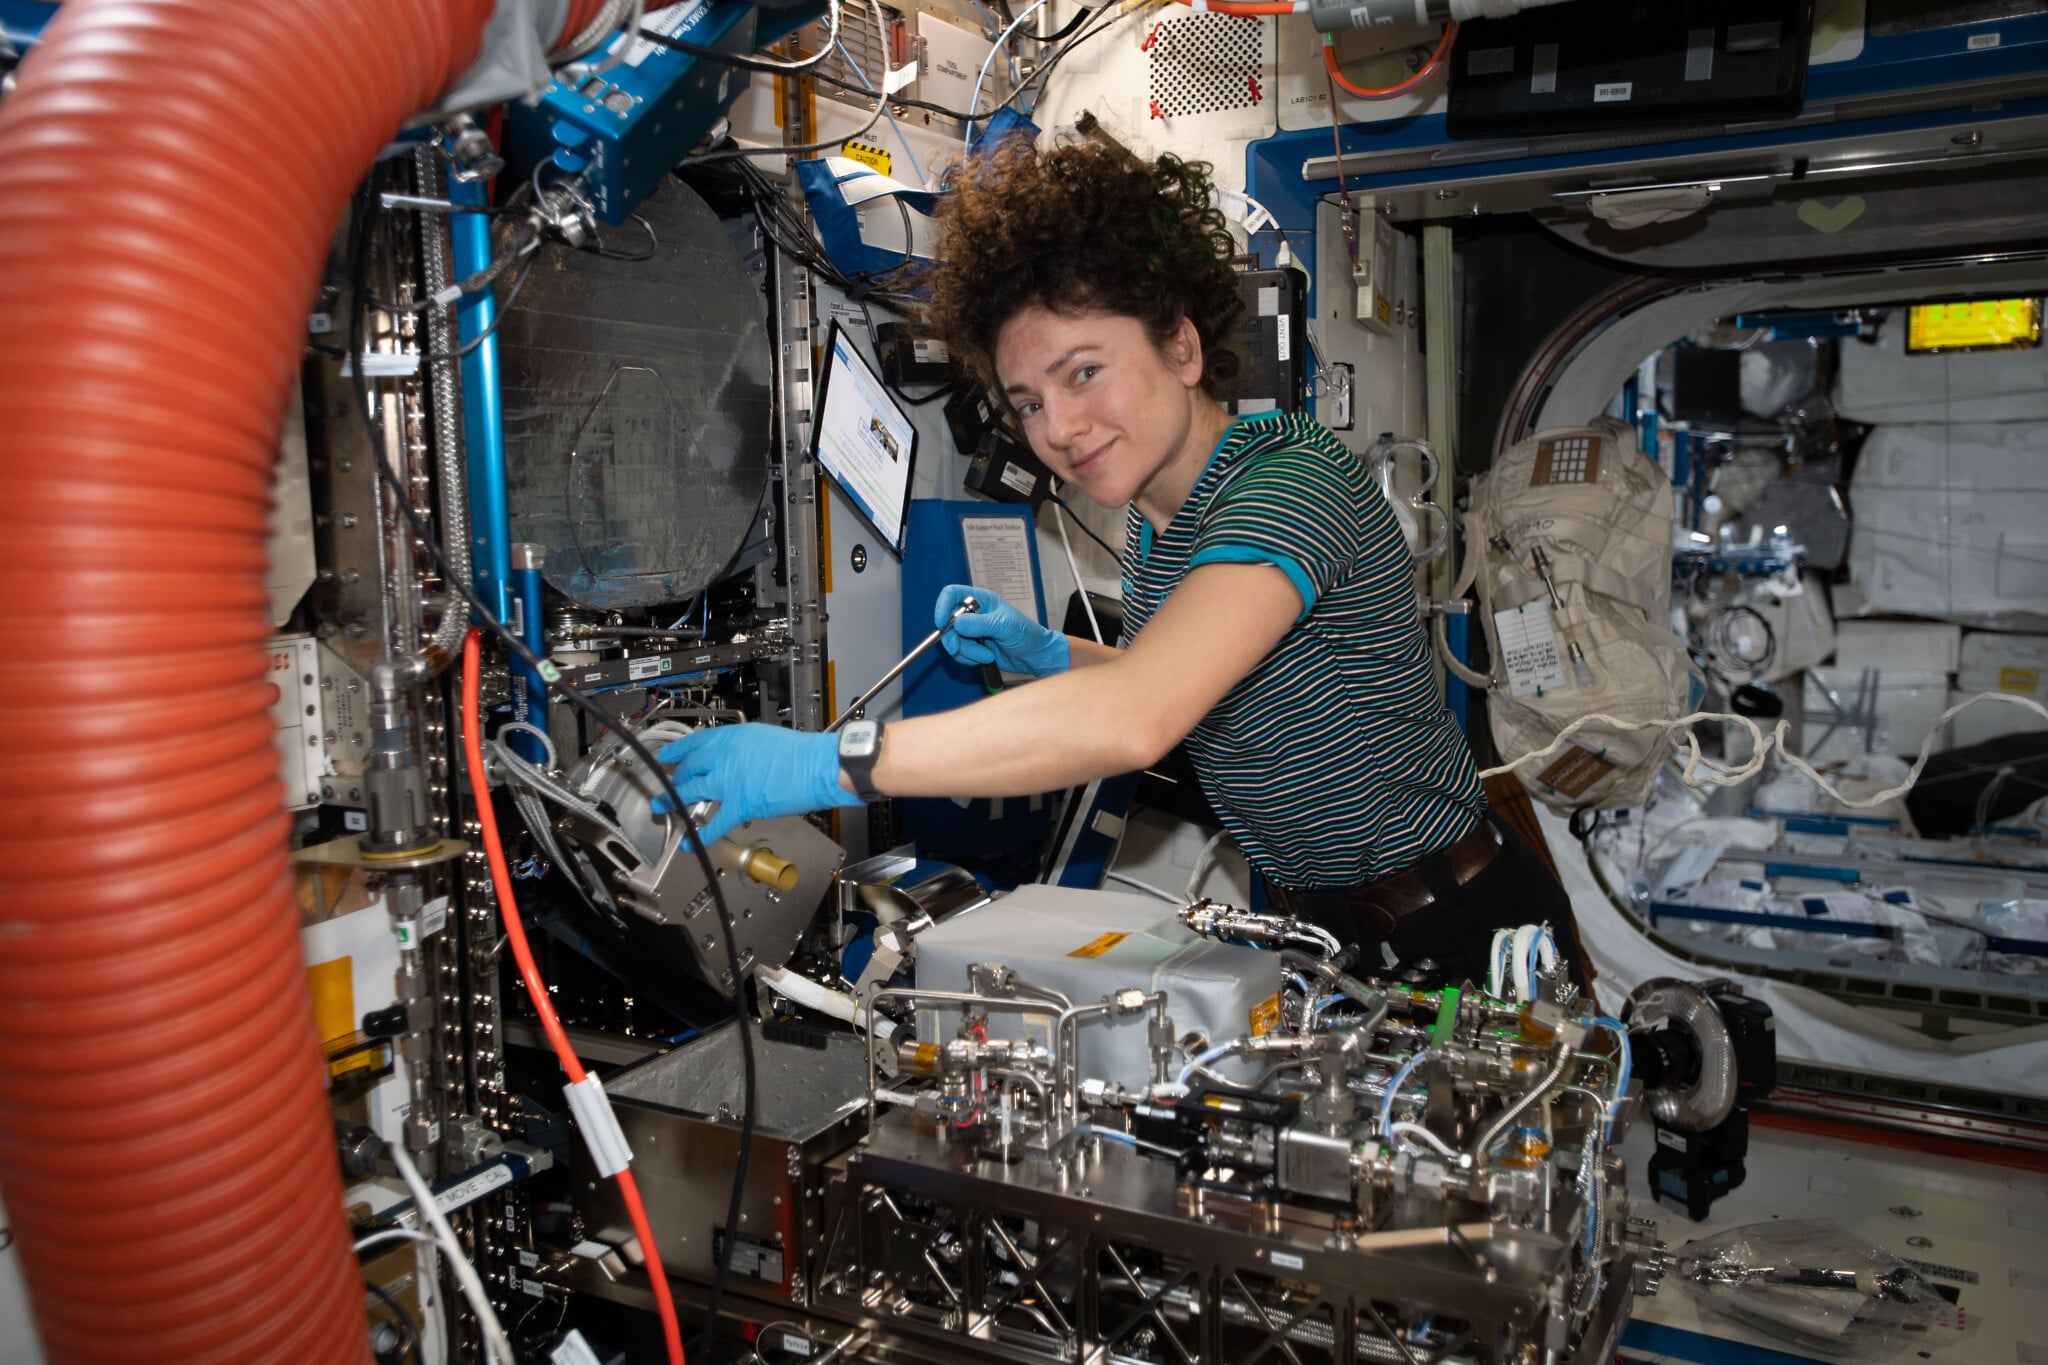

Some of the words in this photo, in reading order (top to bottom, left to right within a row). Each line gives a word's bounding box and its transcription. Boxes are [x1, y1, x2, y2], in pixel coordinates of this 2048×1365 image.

[946, 59, 958, 70] TOOL
[936, 64, 968, 81] COMPARTMENT
[855, 153, 879, 166] CAUTION
[446, 1182, 479, 1202] MOVE
